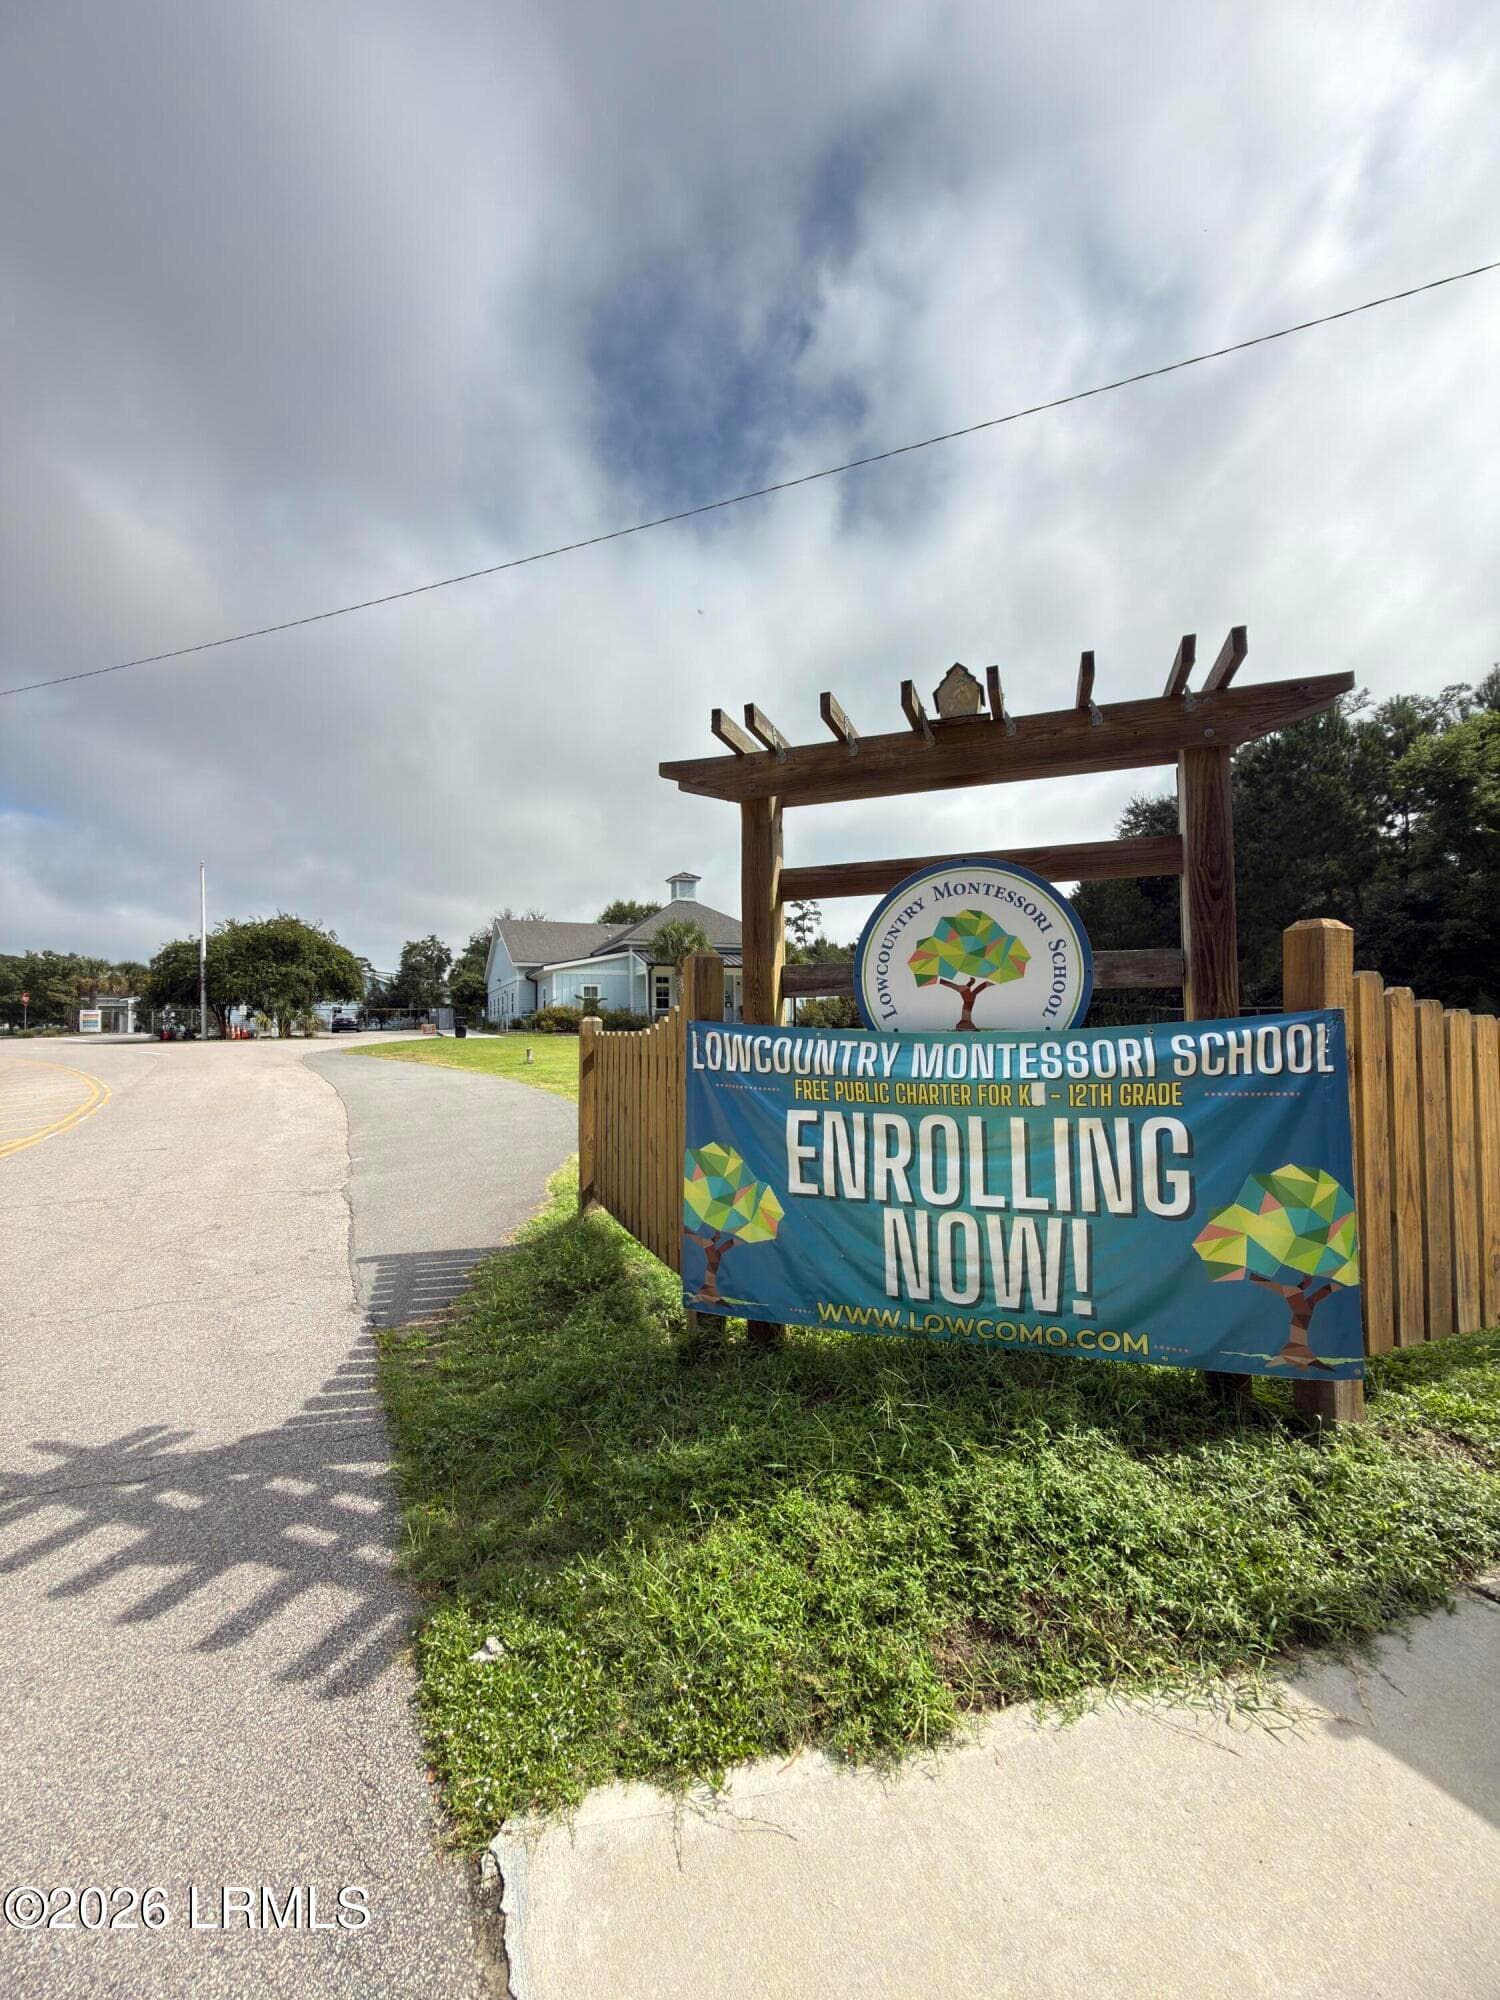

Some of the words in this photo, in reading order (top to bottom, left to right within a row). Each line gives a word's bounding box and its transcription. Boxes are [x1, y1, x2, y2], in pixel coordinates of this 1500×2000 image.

[691, 1030, 901, 1078] LOWCOUNTRY
[910, 1036, 1157, 1080] MONTESSORI
[1170, 1023, 1335, 1076] SCHOOL
[794, 1079, 830, 1101] FREE
[835, 1080, 890, 1104] PUBLIC
[895, 1083, 972, 1106] CHARTER
[978, 1084, 1012, 1106] FOR
[1067, 1083, 1112, 1107] 12TH
[1119, 1082, 1183, 1106] GRADE
[785, 1108, 1193, 1217] ENROLLING
[882, 1207, 1095, 1316] NOW!
[816, 1301, 1150, 1356] WWW.LOWCOMO.COM
